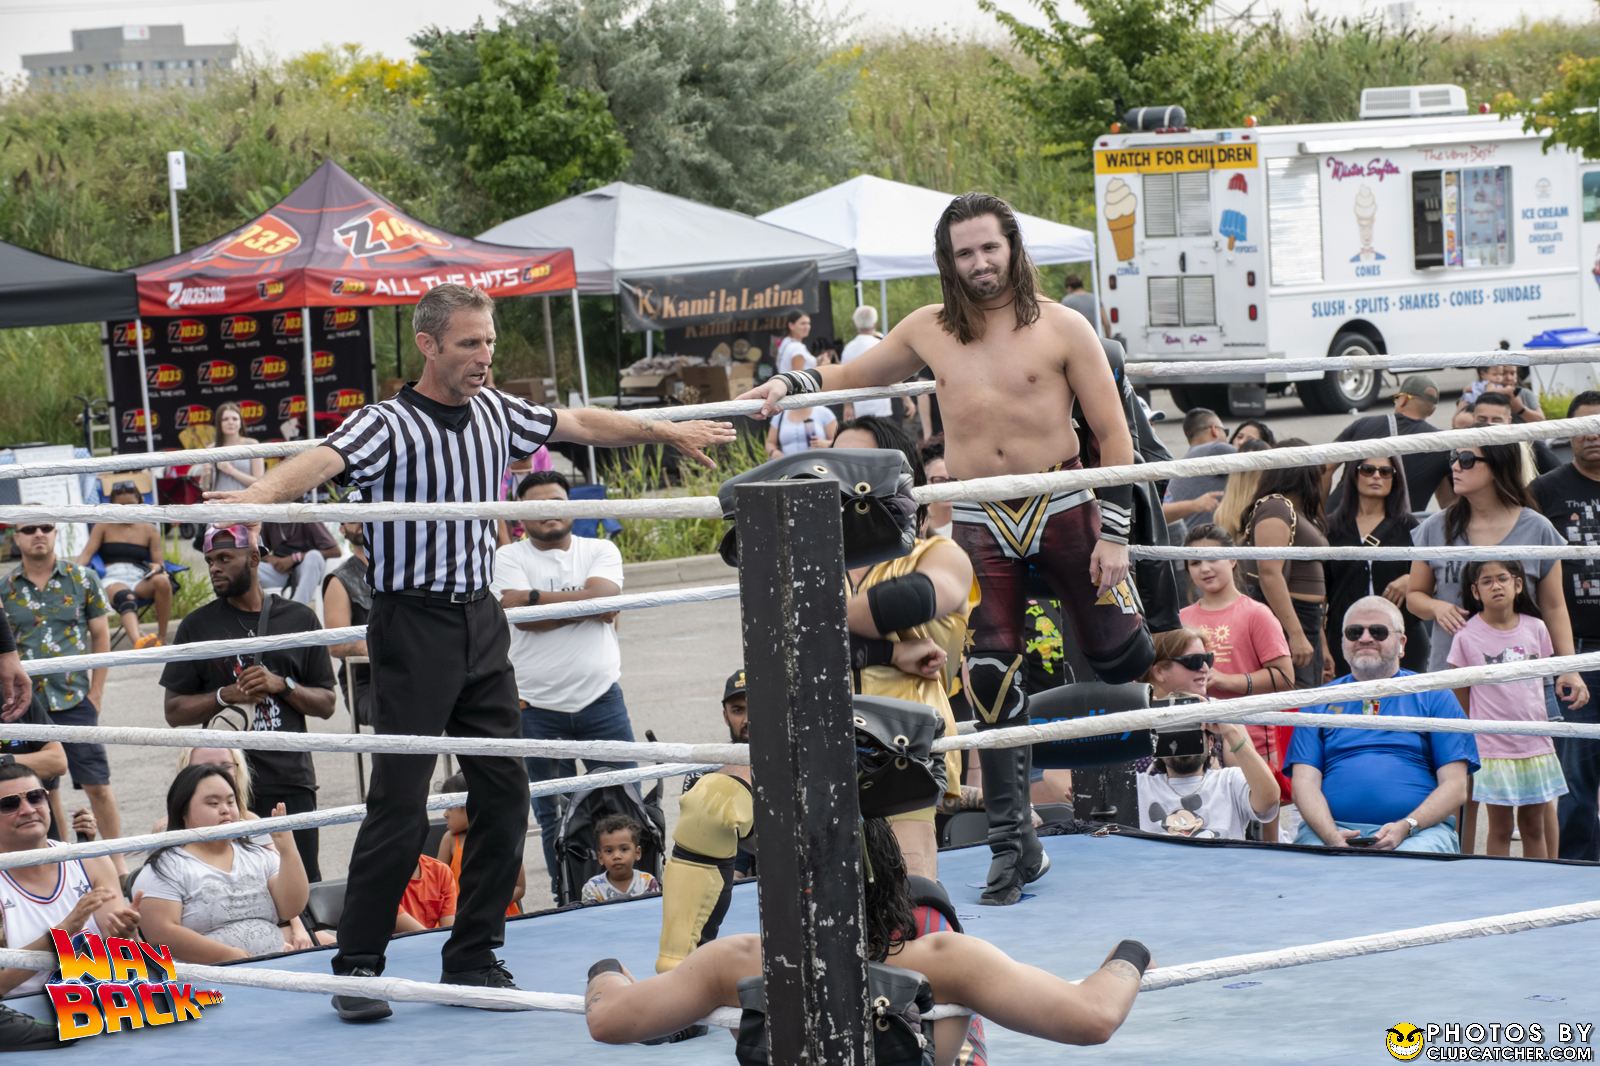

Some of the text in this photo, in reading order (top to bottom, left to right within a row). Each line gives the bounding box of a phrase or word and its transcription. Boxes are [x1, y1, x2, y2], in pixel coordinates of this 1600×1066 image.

[1105, 147, 1252, 168] WATCH FOR CHILDREN
[1326, 156, 1364, 181] Mister
[1522, 206, 1569, 220] ICE CREAM
[371, 278, 420, 296] ALL
[470, 268, 519, 289] HITS
[1355, 265, 1381, 277] CONES
[662, 290, 716, 319] Kami
[741, 284, 804, 311] Latina
[1312, 285, 1541, 318] SLUSH SPLITS SHAKES CONES SUNDAES
[1565, 499, 1587, 508] The
